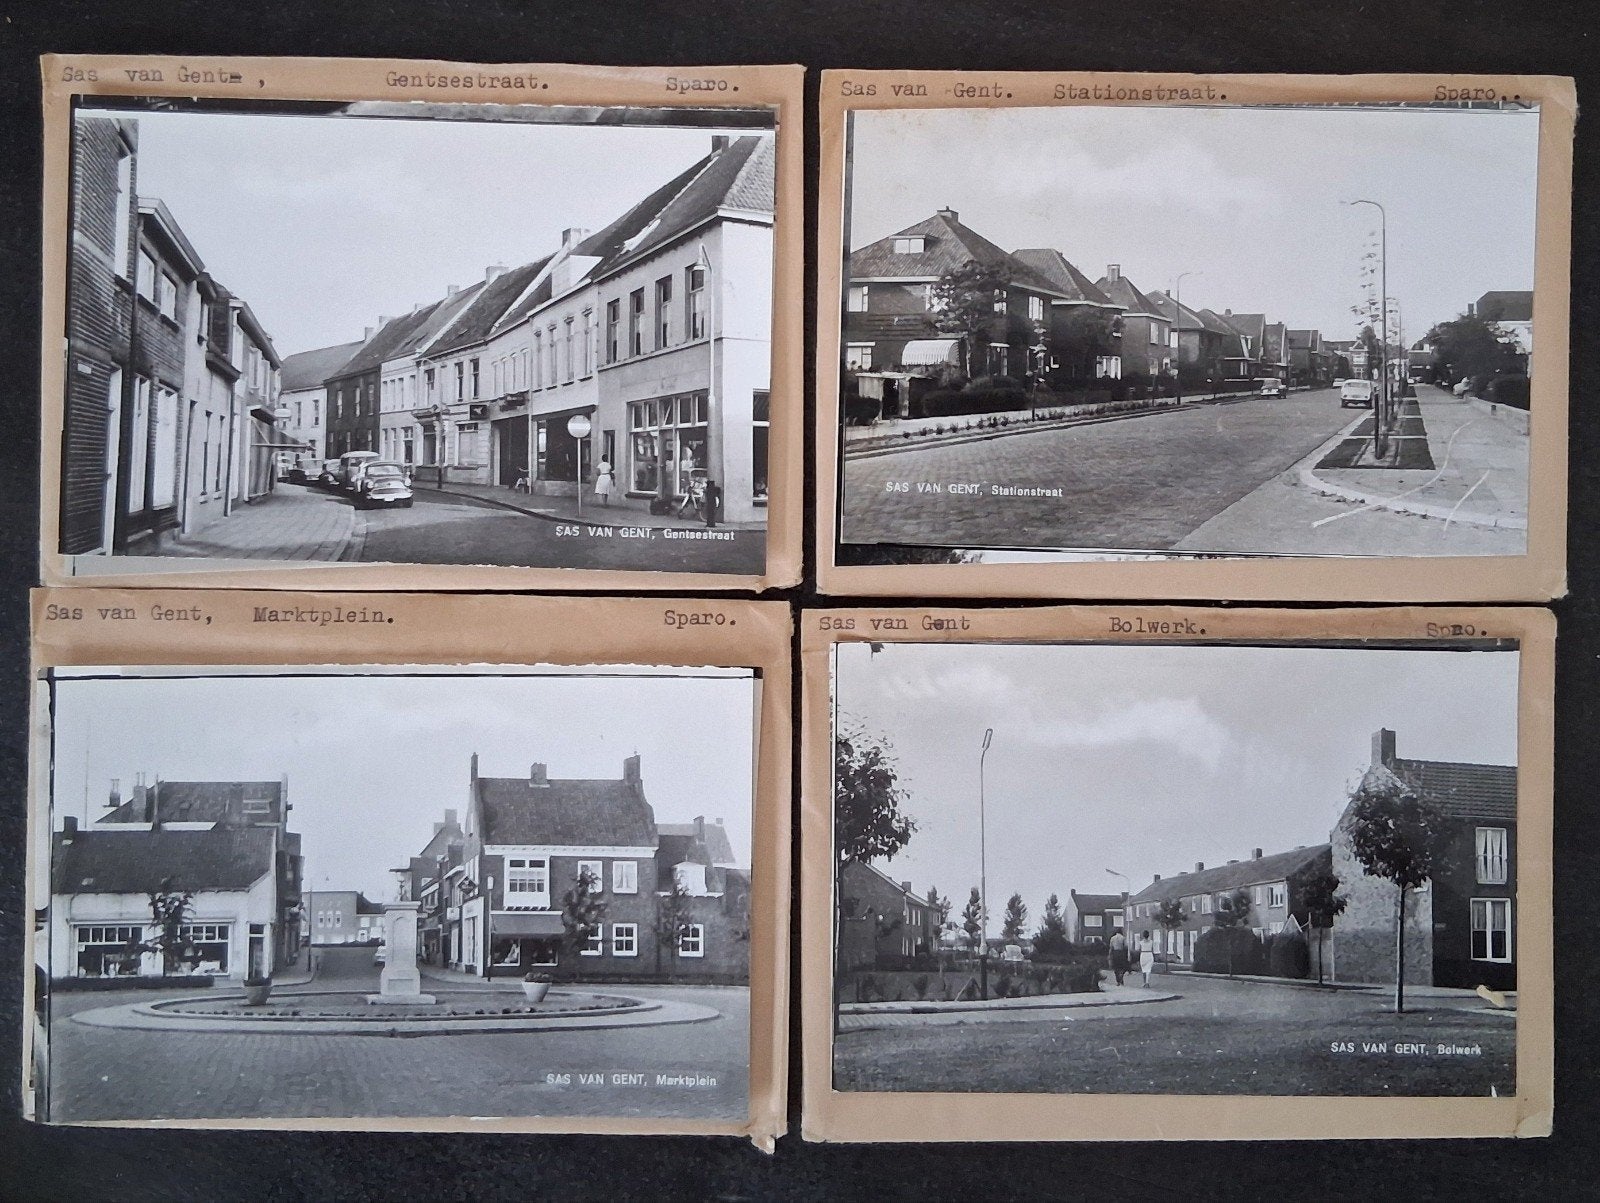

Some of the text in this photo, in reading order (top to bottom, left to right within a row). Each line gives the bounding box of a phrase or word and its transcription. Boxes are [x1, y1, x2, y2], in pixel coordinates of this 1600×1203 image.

[61, 66, 99, 83] Sas
[124, 69, 165, 83] van
[385, 71, 549, 90] Gentsestraat.
[665, 77, 740, 95] Sparo.
[840, 80, 1013, 99] Sas van Gent.
[1053, 84, 1228, 101] Stationstraat.
[885, 481, 1063, 498] SAS VAN GENT, Stationstraat
[555, 525, 735, 541] SAS VAN GENT, Gentsestraat
[45, 604, 213, 625] Sas van Gent,
[253, 606, 395, 627] Marktplein.
[664, 609, 737, 627] Sparo.
[818, 616, 856, 631] Sas
[870, 618, 909, 631] van
[1108, 616, 1207, 635] Bolwerk.
[1330, 1041, 1482, 1056] SAS VAN GENT, Bolwerk
[546, 1073, 717, 1088] SAS VAN GENT, Marktplein
